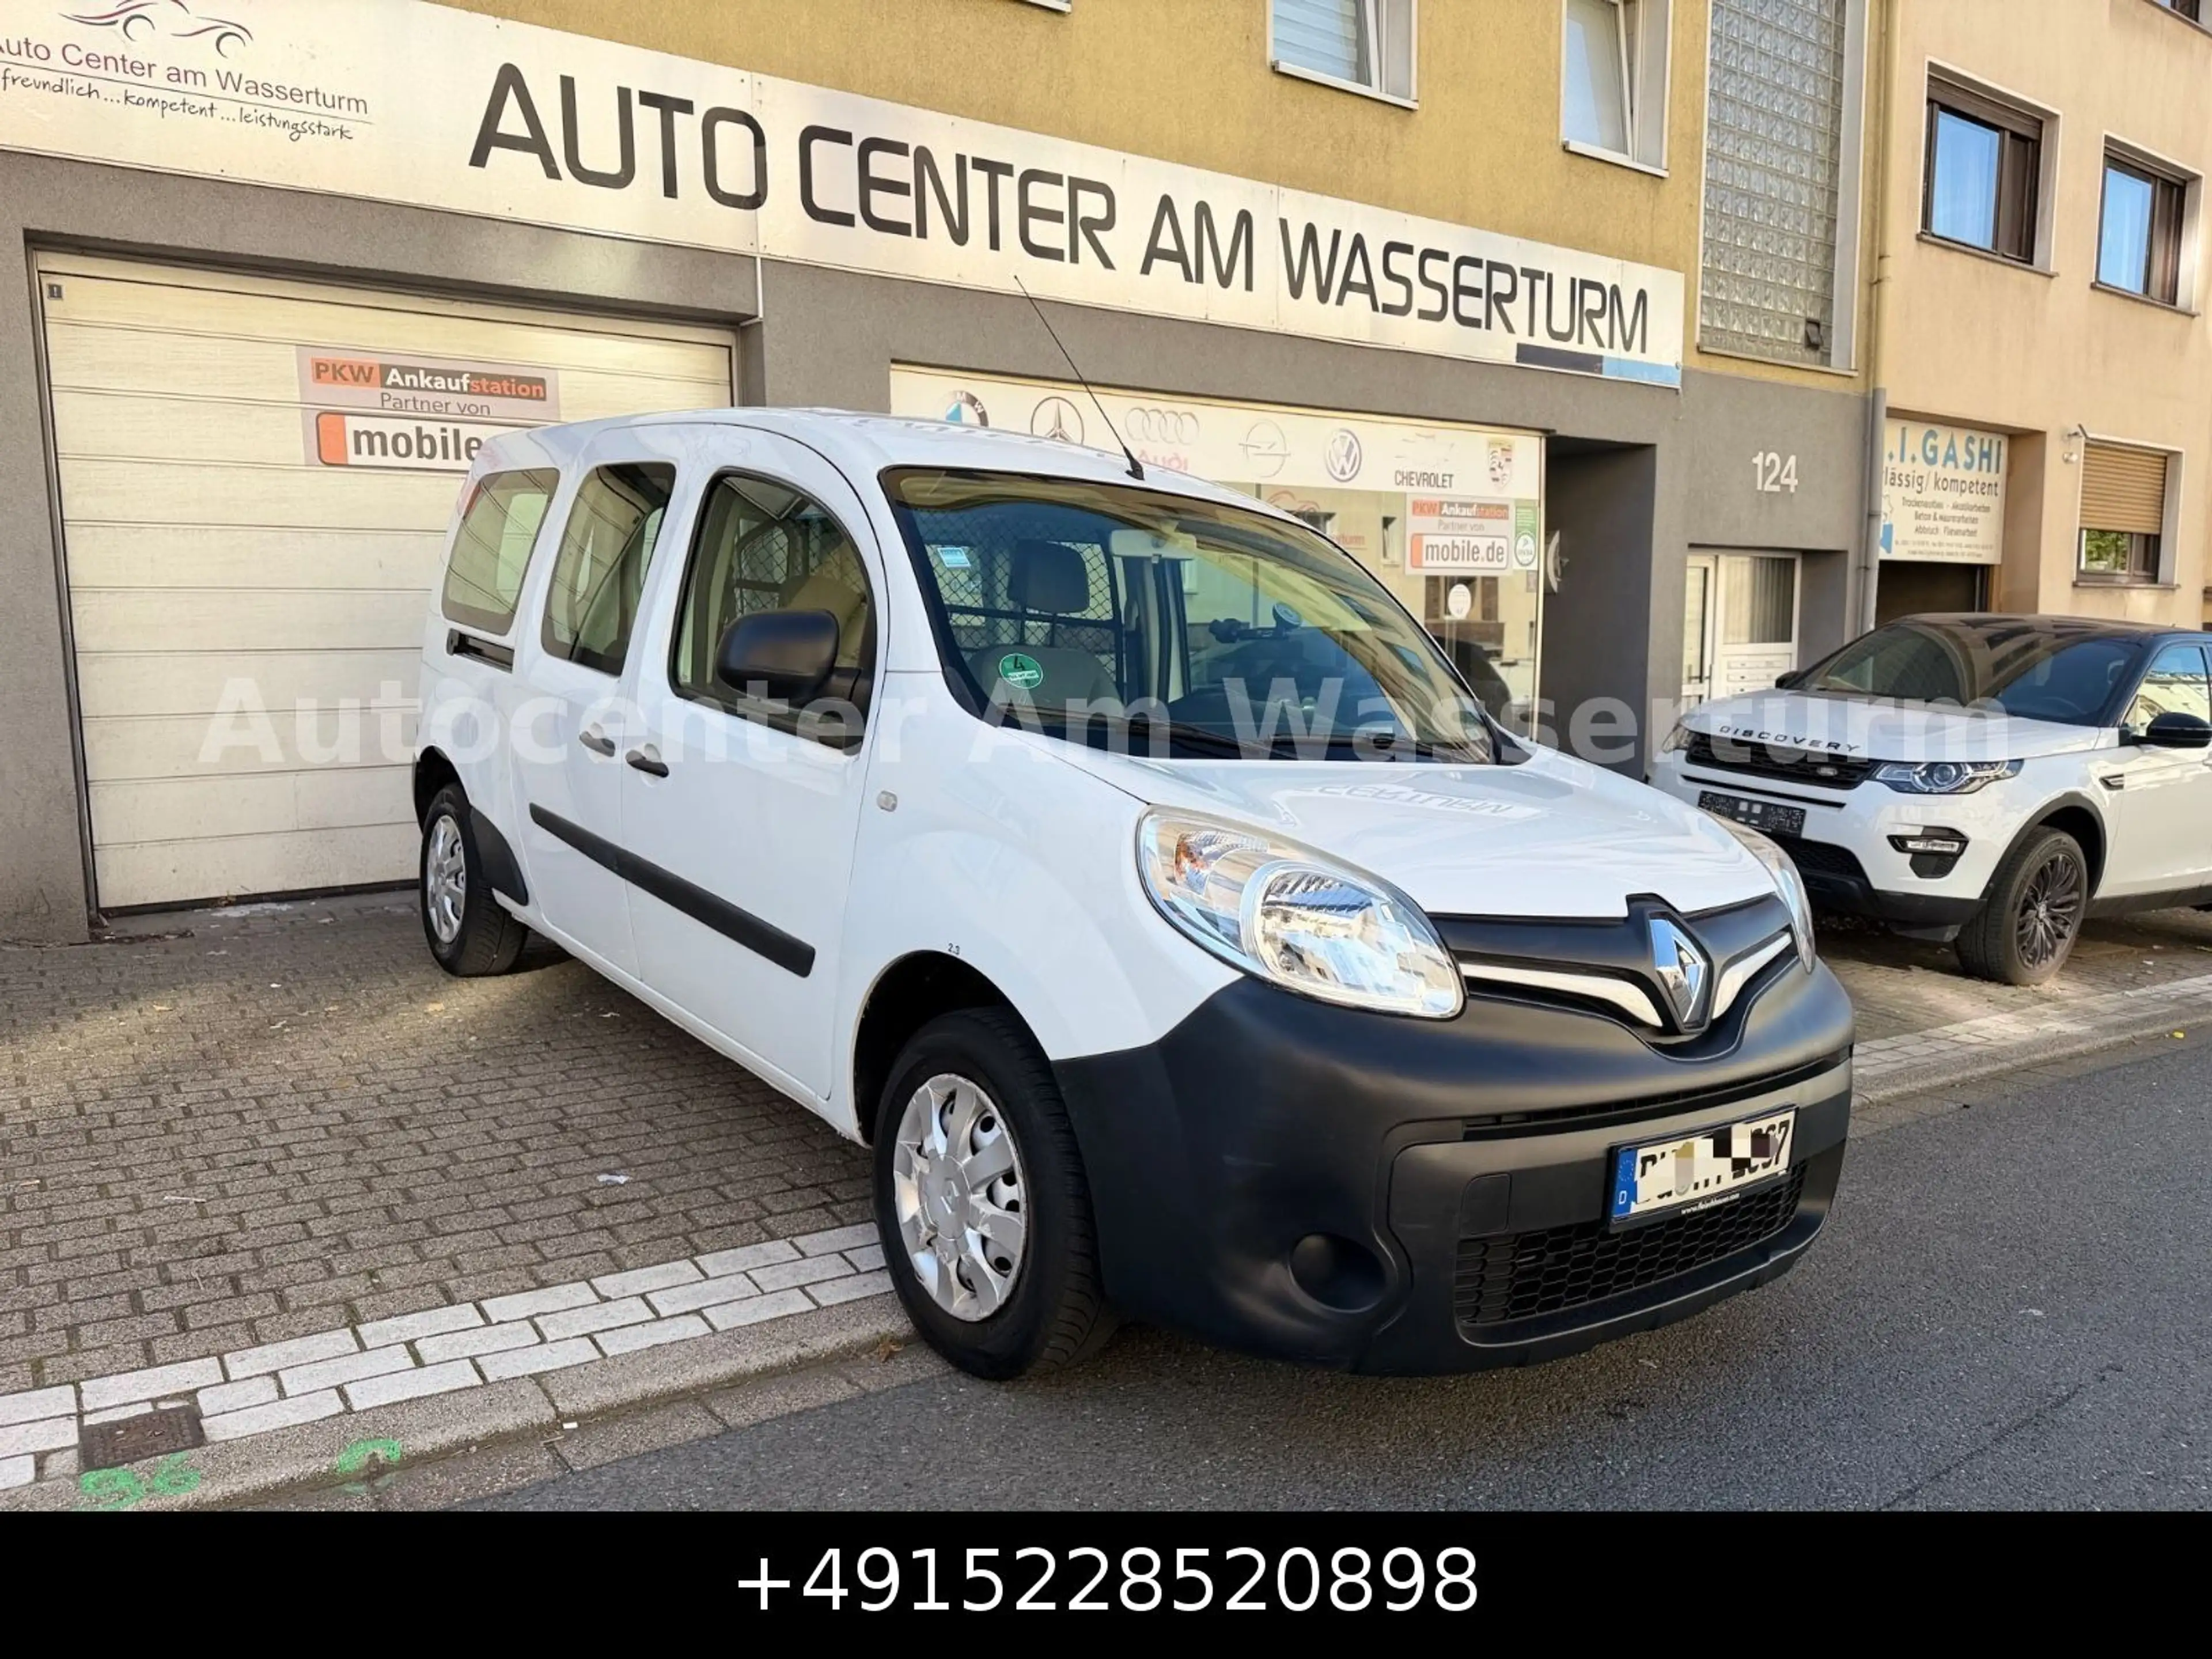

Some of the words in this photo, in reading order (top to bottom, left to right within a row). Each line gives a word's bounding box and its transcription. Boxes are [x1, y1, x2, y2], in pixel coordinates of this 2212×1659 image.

[0, 37, 51, 60] uto
[61, 43, 157, 78] Center
[166, 66, 207, 87] am
[215, 69, 368, 115] Wasserturm
[469, 63, 768, 211] AUTO
[798, 124, 1116, 270] CENTER
[1140, 194, 1253, 292] AM
[1278, 217, 1647, 354] WASSERTURM
[314, 361, 374, 384] PKW
[385, 367, 545, 398] Ankaufstation
[380, 392, 451, 414] Partner
[456, 402, 491, 416] von
[1394, 469, 1455, 489] CHEVROLET
[1751, 450, 1798, 493] 124
[1882, 467, 1930, 495] lässig/
[1934, 471, 1999, 497] kompetent
[1414, 501, 1438, 516] PKW
[1442, 502, 1508, 519] Ankaufstation
[1438, 519, 1467, 532] Partner
[1469, 522, 1485, 532] von
[1425, 539, 1505, 563] mobile.de
[1719, 725, 1861, 752] DISCOVERY
[1618, 1190, 1627, 1205] D
